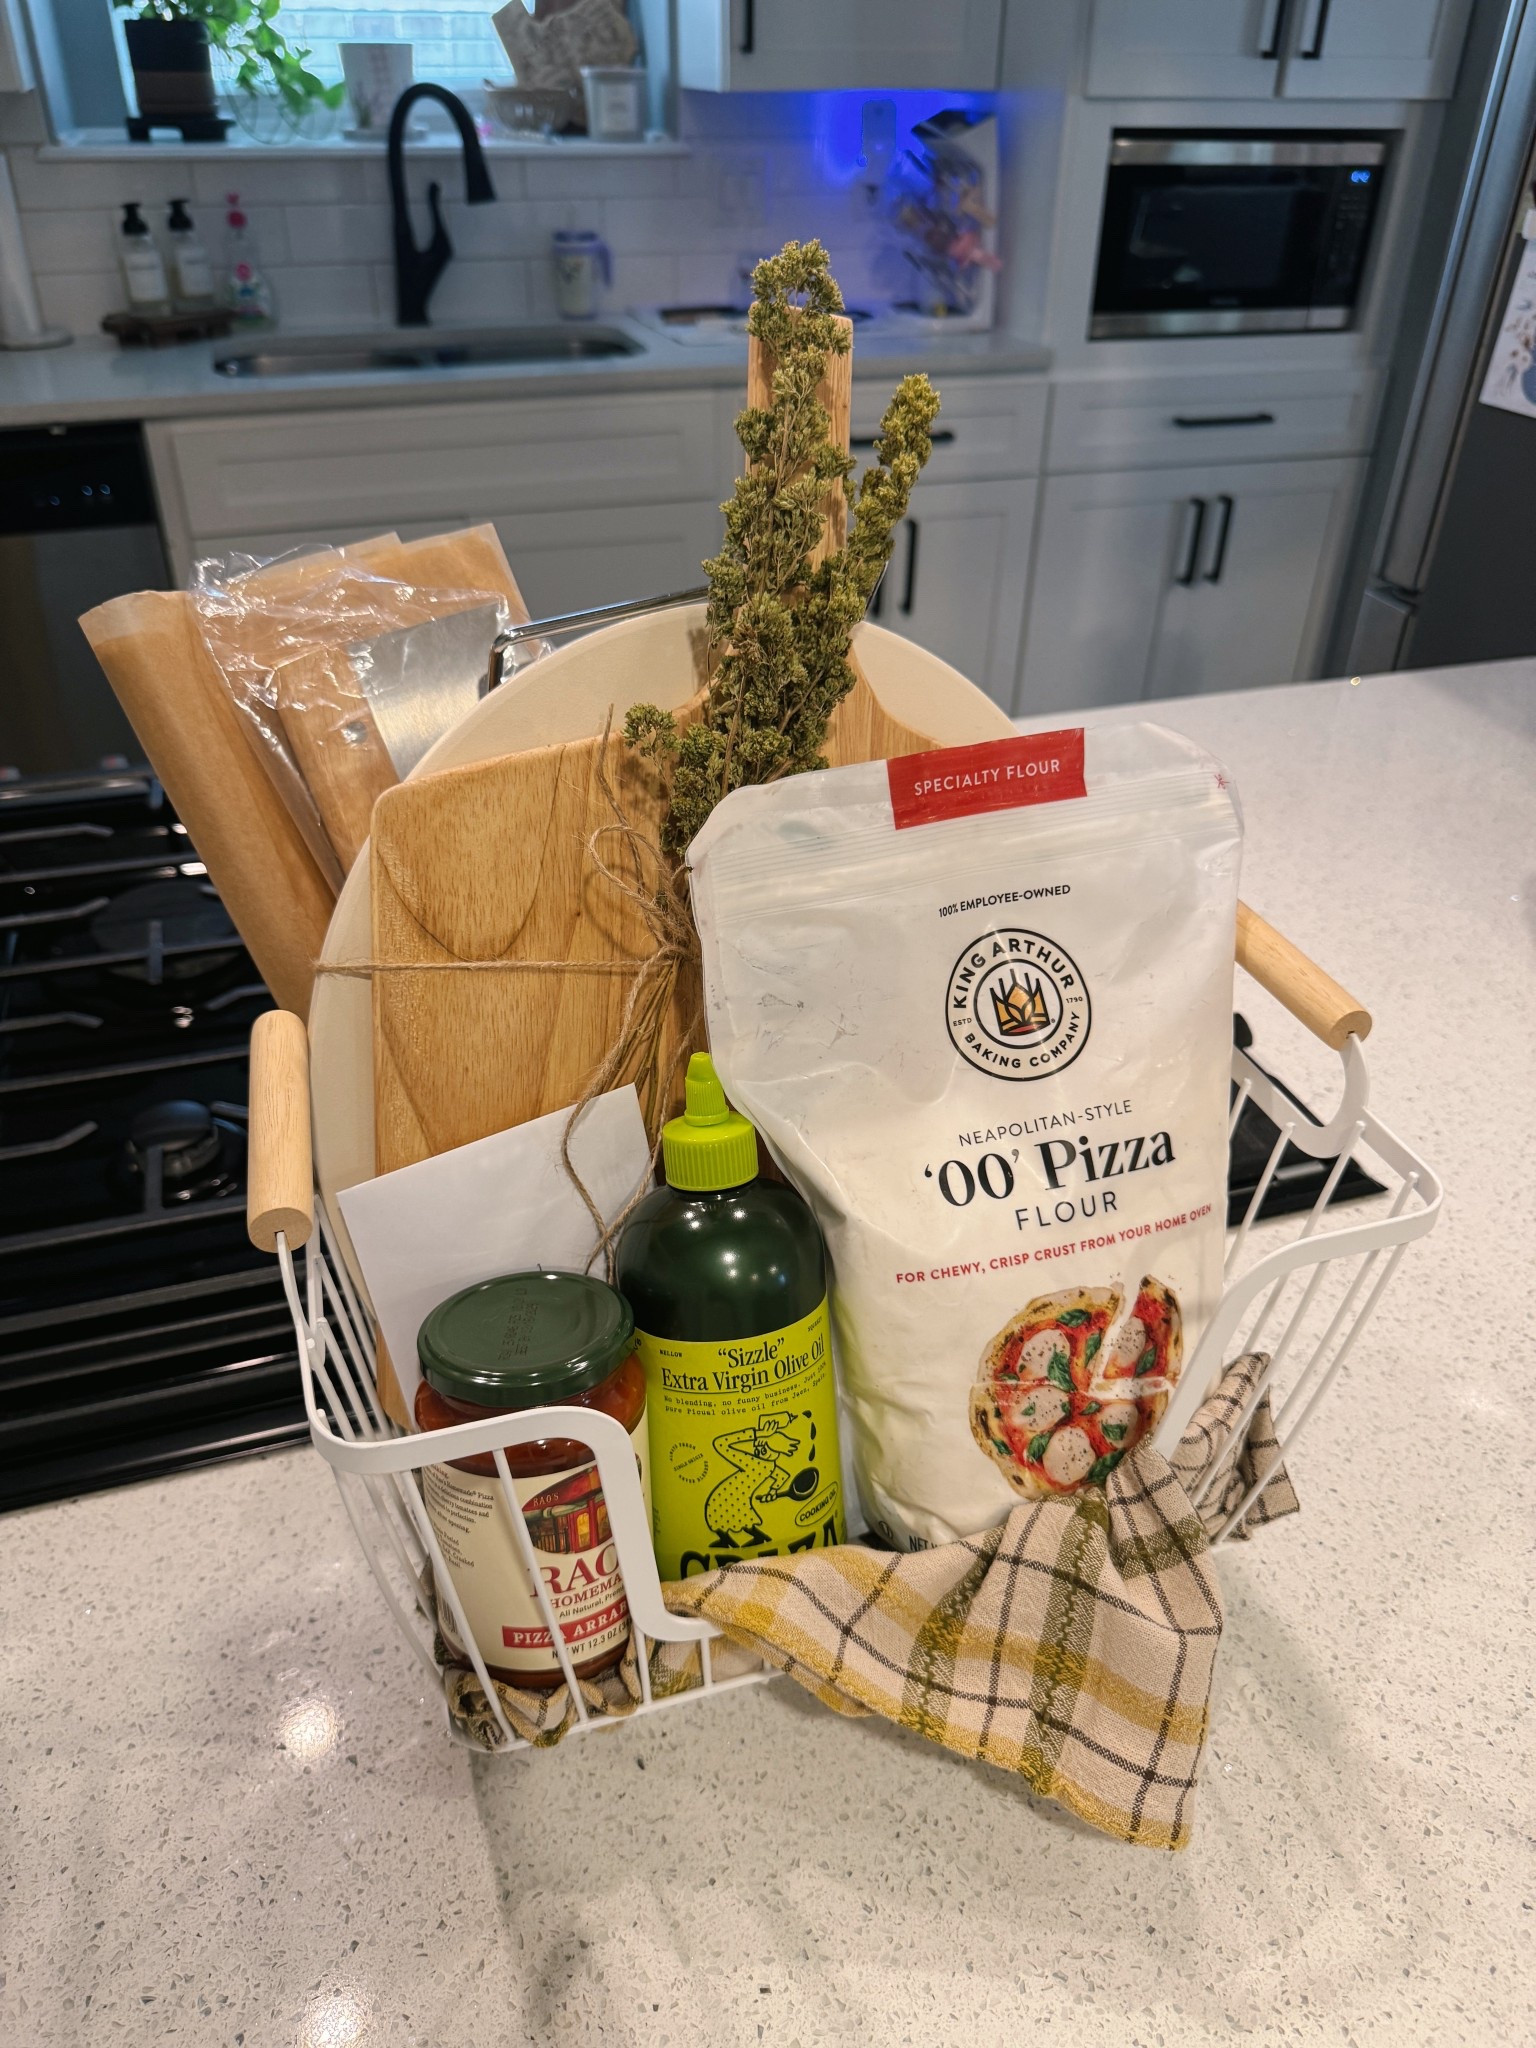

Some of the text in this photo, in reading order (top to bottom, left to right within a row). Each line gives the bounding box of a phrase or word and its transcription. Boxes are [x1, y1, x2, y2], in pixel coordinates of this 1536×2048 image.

[914, 759, 1061, 796] SPECIALTY FLOUR
[938, 884, 1071, 917] 100% EMPLOYEE-OWNED
[953, 938, 1075, 1009] KING ARTHUR
[1065, 996, 1083, 1004] 1790
[953, 1017, 972, 1027] ESTD
[965, 1011, 1080, 1068] BAKING COMPANY
[959, 1099, 1132, 1147] NEAPOLITAN-STYLE
[1034, 1131, 1176, 1191] Pizza
[1015, 1191, 1117, 1231] FLOUR
[896, 1203, 1212, 1284] FOR CHEWY, CRISP CRUST FROM YOUR HOME OVEN
[661, 1333, 825, 1394] Extra Virgin Olive Oil
[664, 1395, 673, 1403] No
[676, 1395, 717, 1408] blending,
[737, 1396, 760, 1405] funny
[764, 1383, 801, 1399] business.
[804, 1372, 816, 1384] Just
[665, 1405, 682, 1414] pure
[721, 1406, 747, 1415] olive
[751, 1403, 766, 1412] oil
[771, 1396, 789, 1407] from
[455, 1503, 478, 1516] tomatoes
[460, 1497, 493, 1510] combination
[478, 1492, 495, 1501] Pizza
[533, 1493, 559, 1507] RAO'S
[800, 1489, 836, 1522] COOKING OIL
[527, 1542, 620, 1598] RAO
[551, 1575, 623, 1609] HOMEMA
[559, 1585, 624, 1619] All Natural, Prem
[573, 1604, 628, 1638] ARRAB
[571, 1641, 586, 1655] WT
[588, 1632, 606, 1648] 12.3
[607, 1628, 618, 1640] OZ
